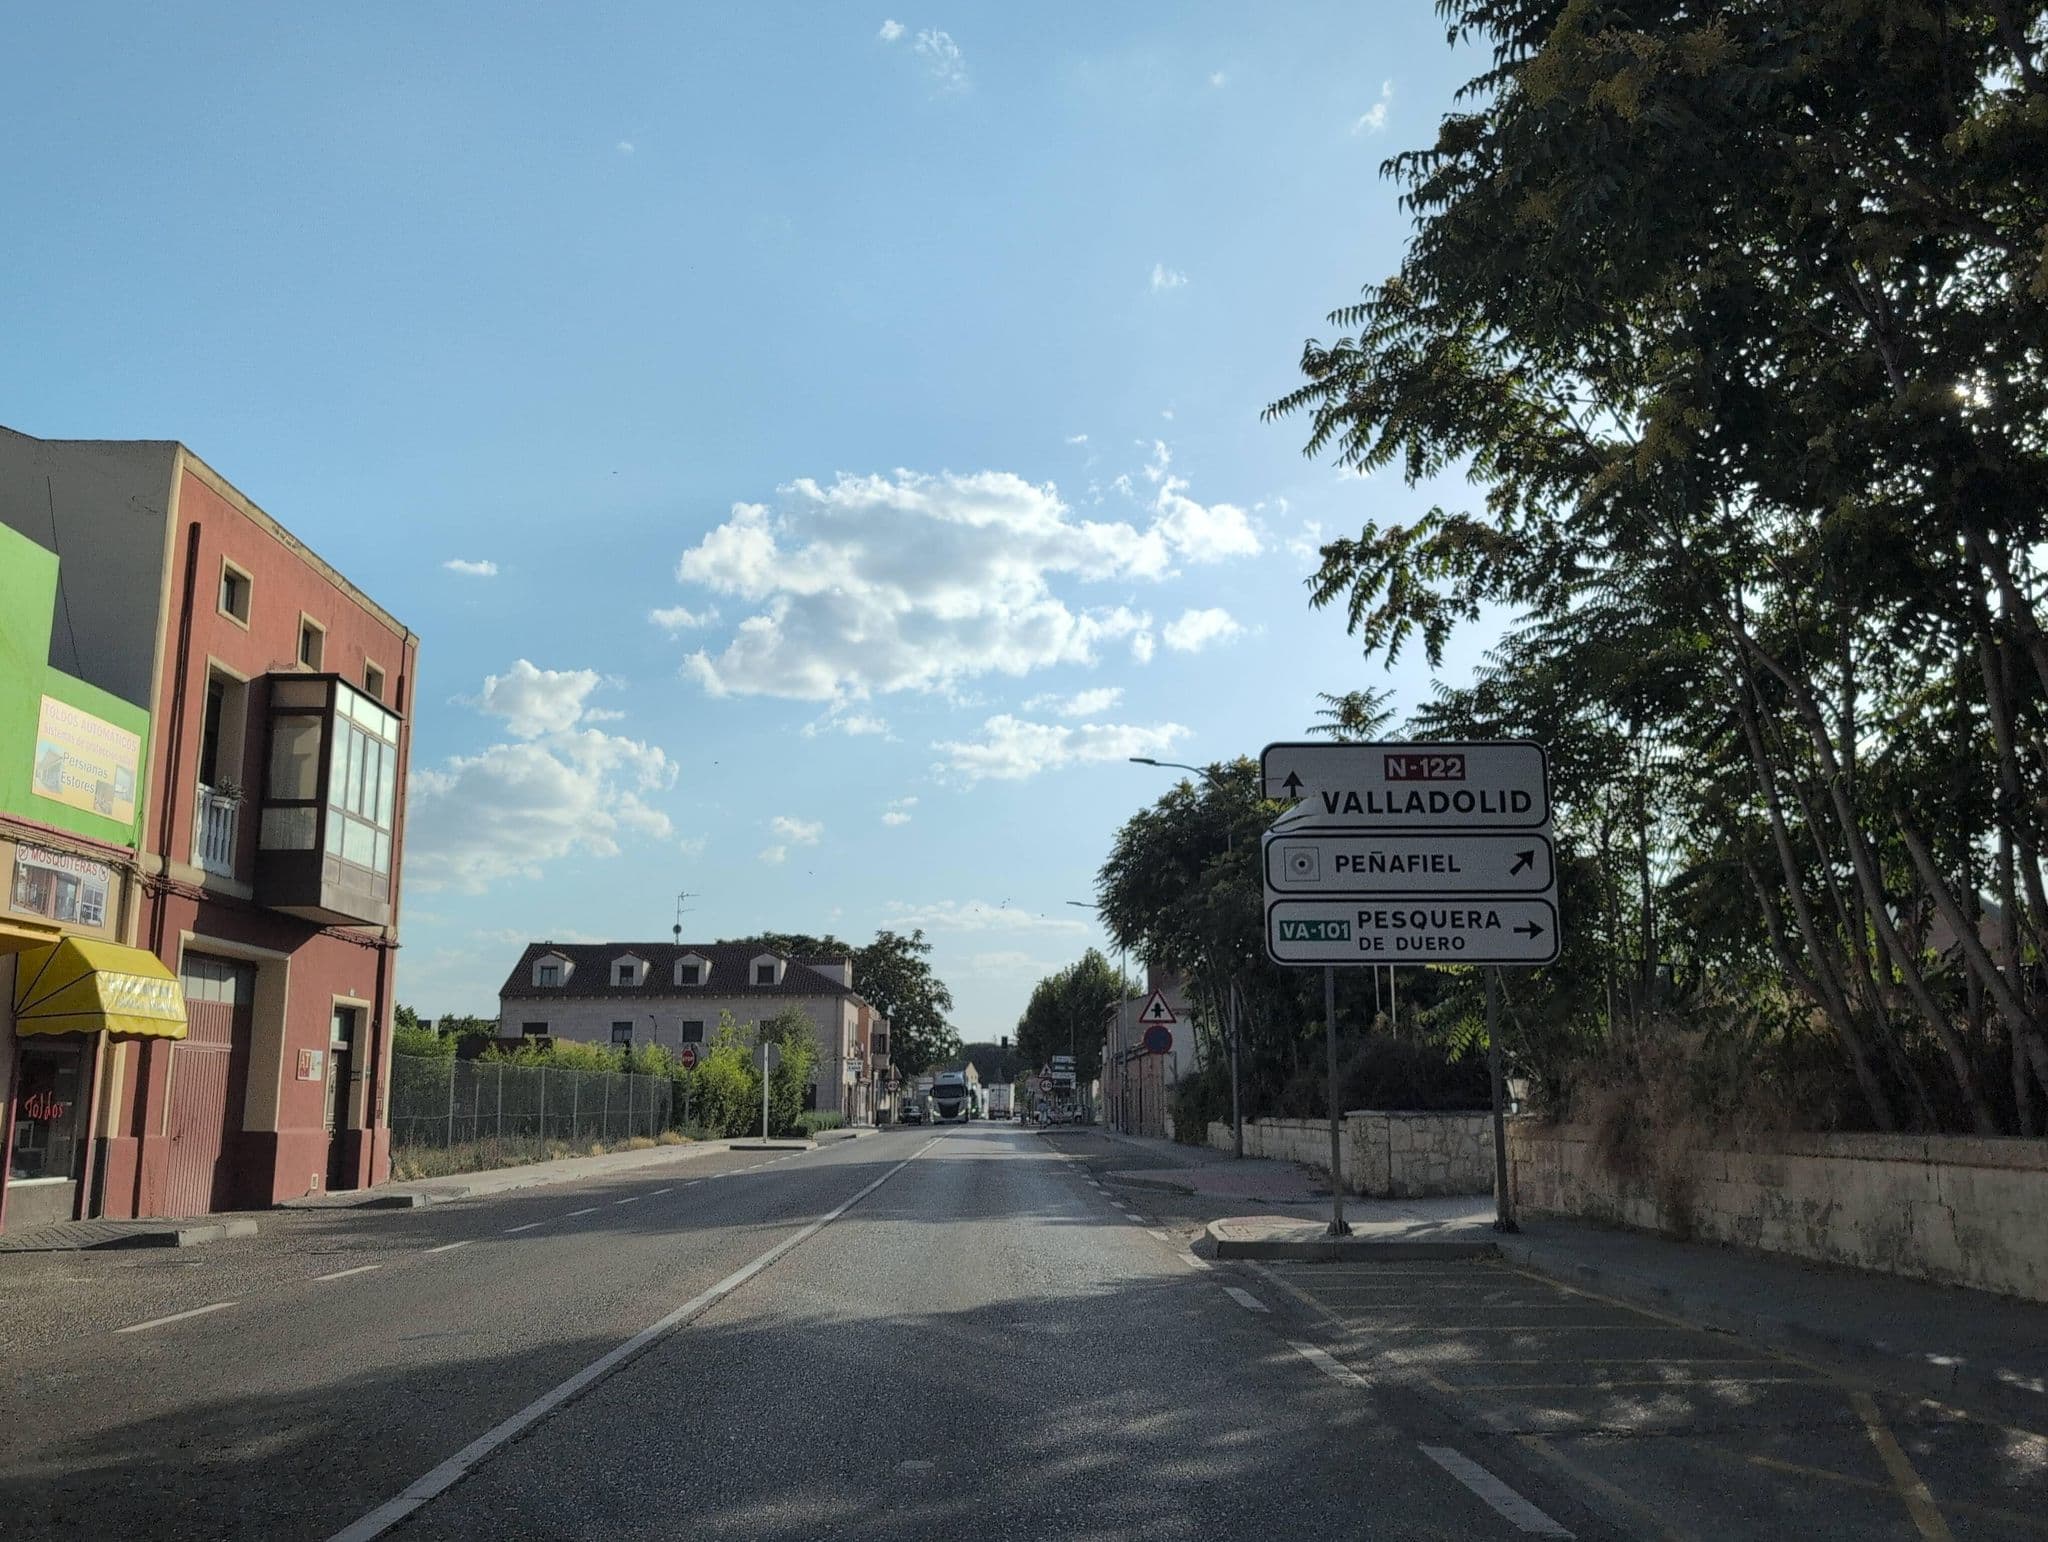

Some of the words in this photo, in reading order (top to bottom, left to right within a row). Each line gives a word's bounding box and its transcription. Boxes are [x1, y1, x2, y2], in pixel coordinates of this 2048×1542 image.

[46, 702, 79, 727] TOLDOS
[63, 751, 108, 779] Persianas
[1388, 758, 1462, 778] N-122
[61, 771, 95, 794] Estores
[1321, 790, 1532, 815] VALLADOLID
[32, 848, 98, 876] MOSQUITERAS
[1335, 851, 1461, 873] PEÑAFIEL
[1282, 922, 1349, 939] VA-101
[1358, 910, 1501, 930] PESQUERA
[1359, 937, 1385, 951] DE
[1396, 936, 1466, 951] DUERO
[25, 1091, 64, 1120] Toldos
